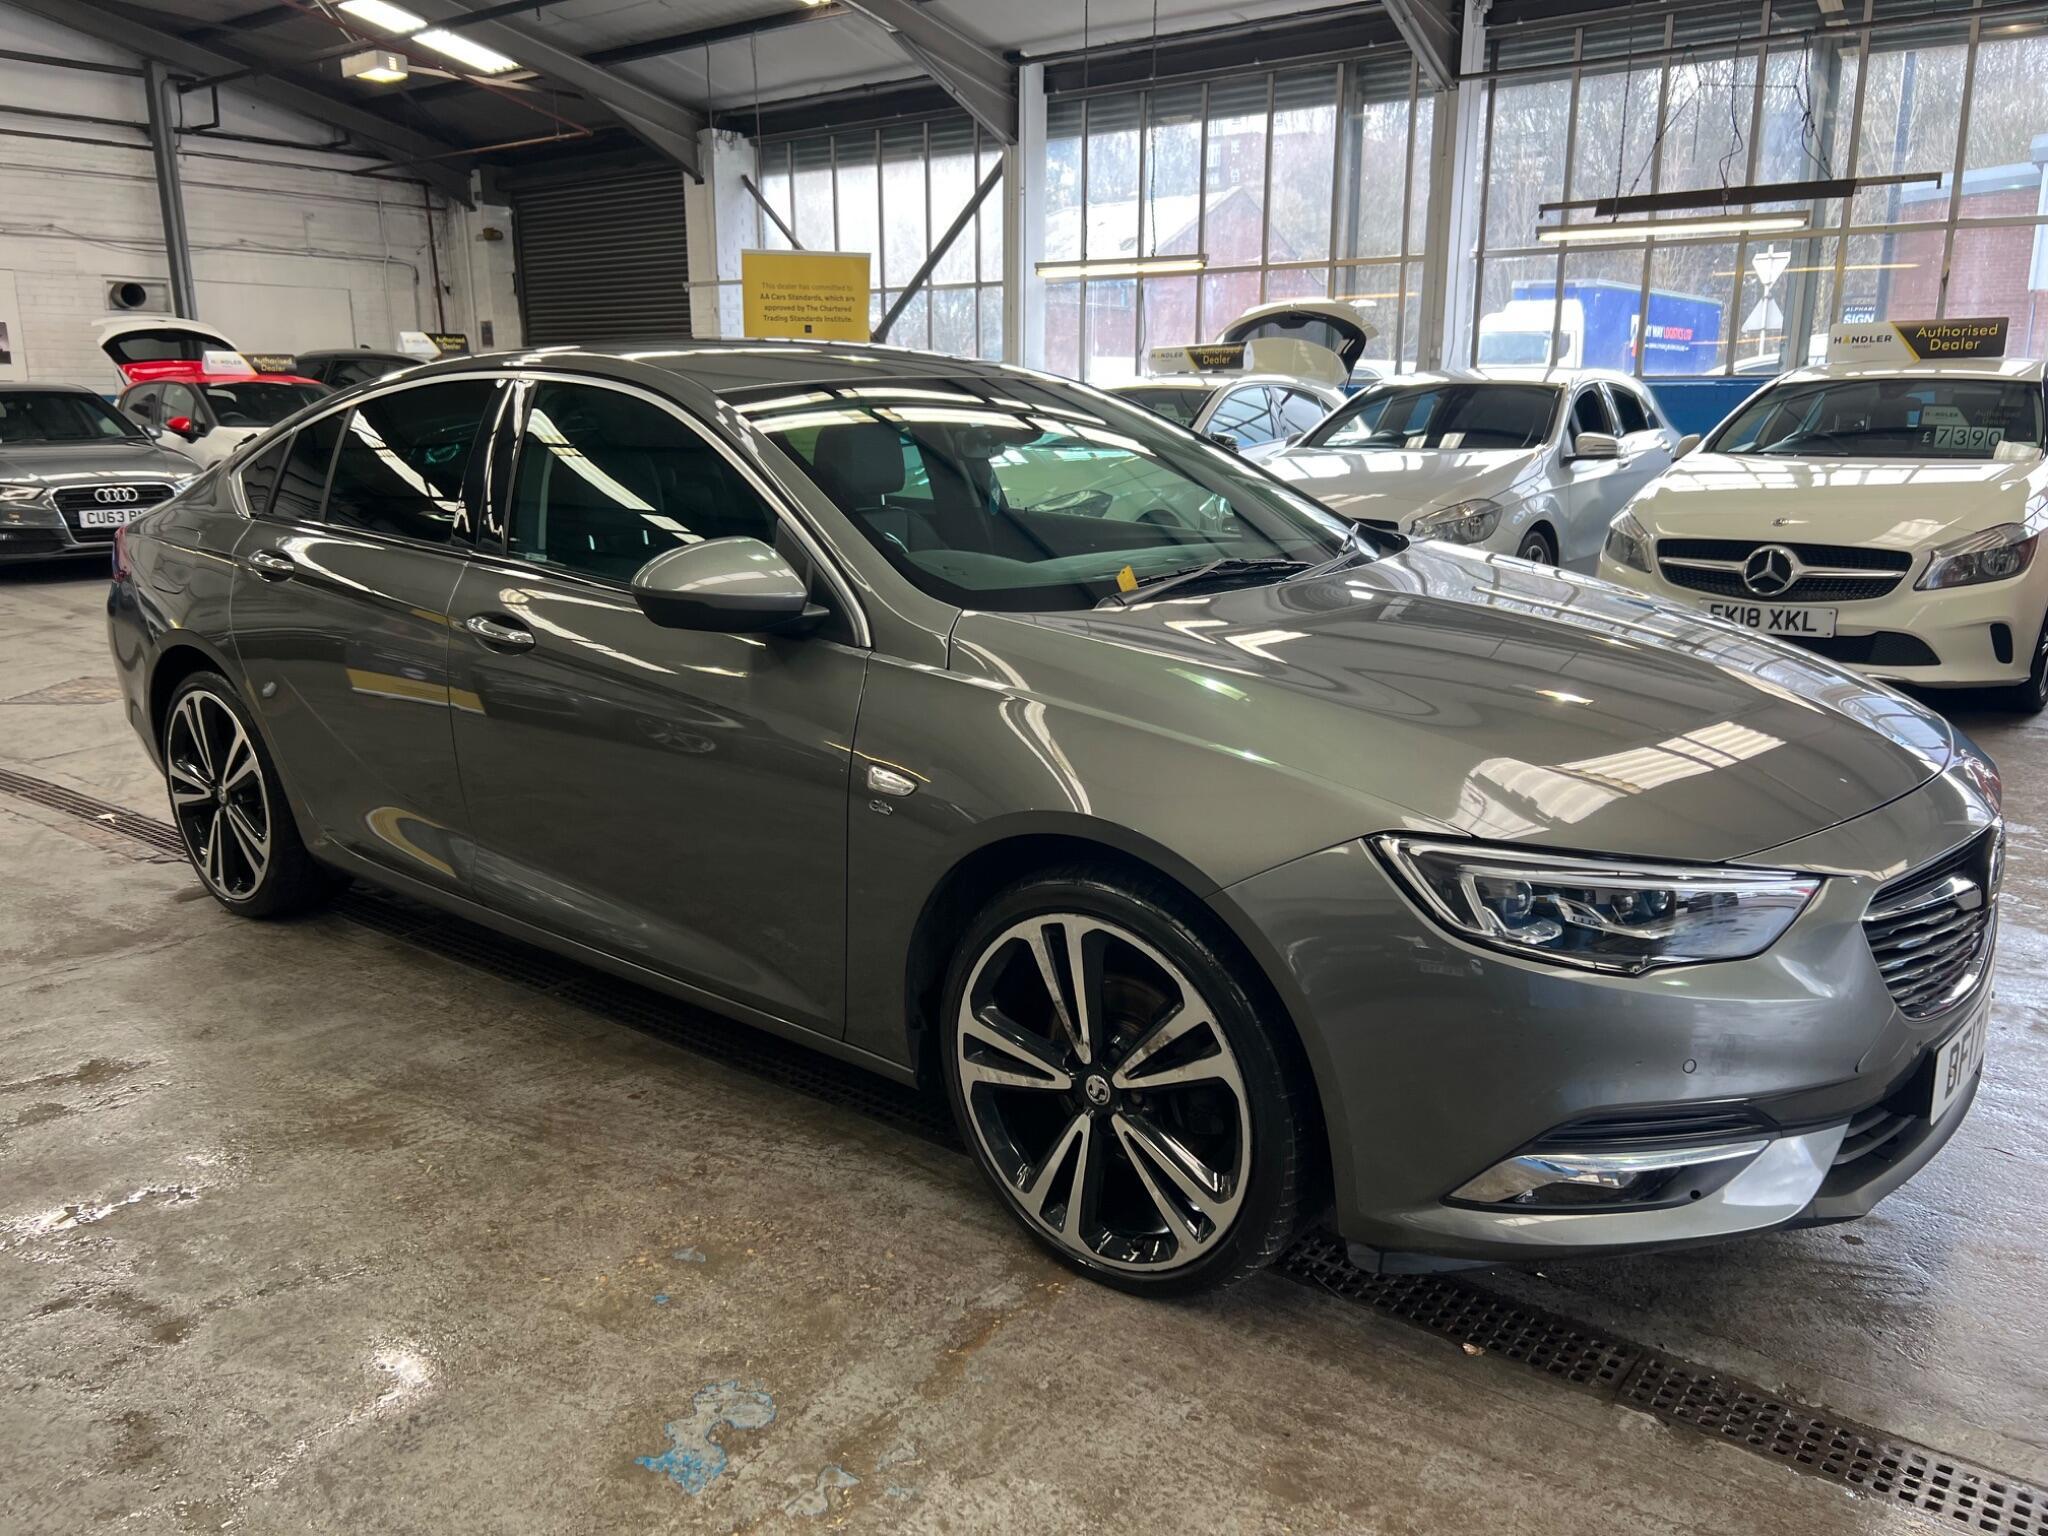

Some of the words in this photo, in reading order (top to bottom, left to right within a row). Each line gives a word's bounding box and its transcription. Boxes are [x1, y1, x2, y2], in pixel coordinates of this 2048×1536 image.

[762, 282, 775, 290] This
[799, 283, 810, 291] has
[812, 284, 846, 292] committed
[763, 315, 788, 323] Trading
[1916, 324, 1998, 339] Authorised
[1930, 339, 1980, 351] Dealer
[253, 356, 293, 365] Authorised
[1203, 355, 1230, 365] Dealer
[261, 364, 286, 372] Dealer
[87, 511, 125, 524] CU63
[1768, 609, 1817, 632] XKL
